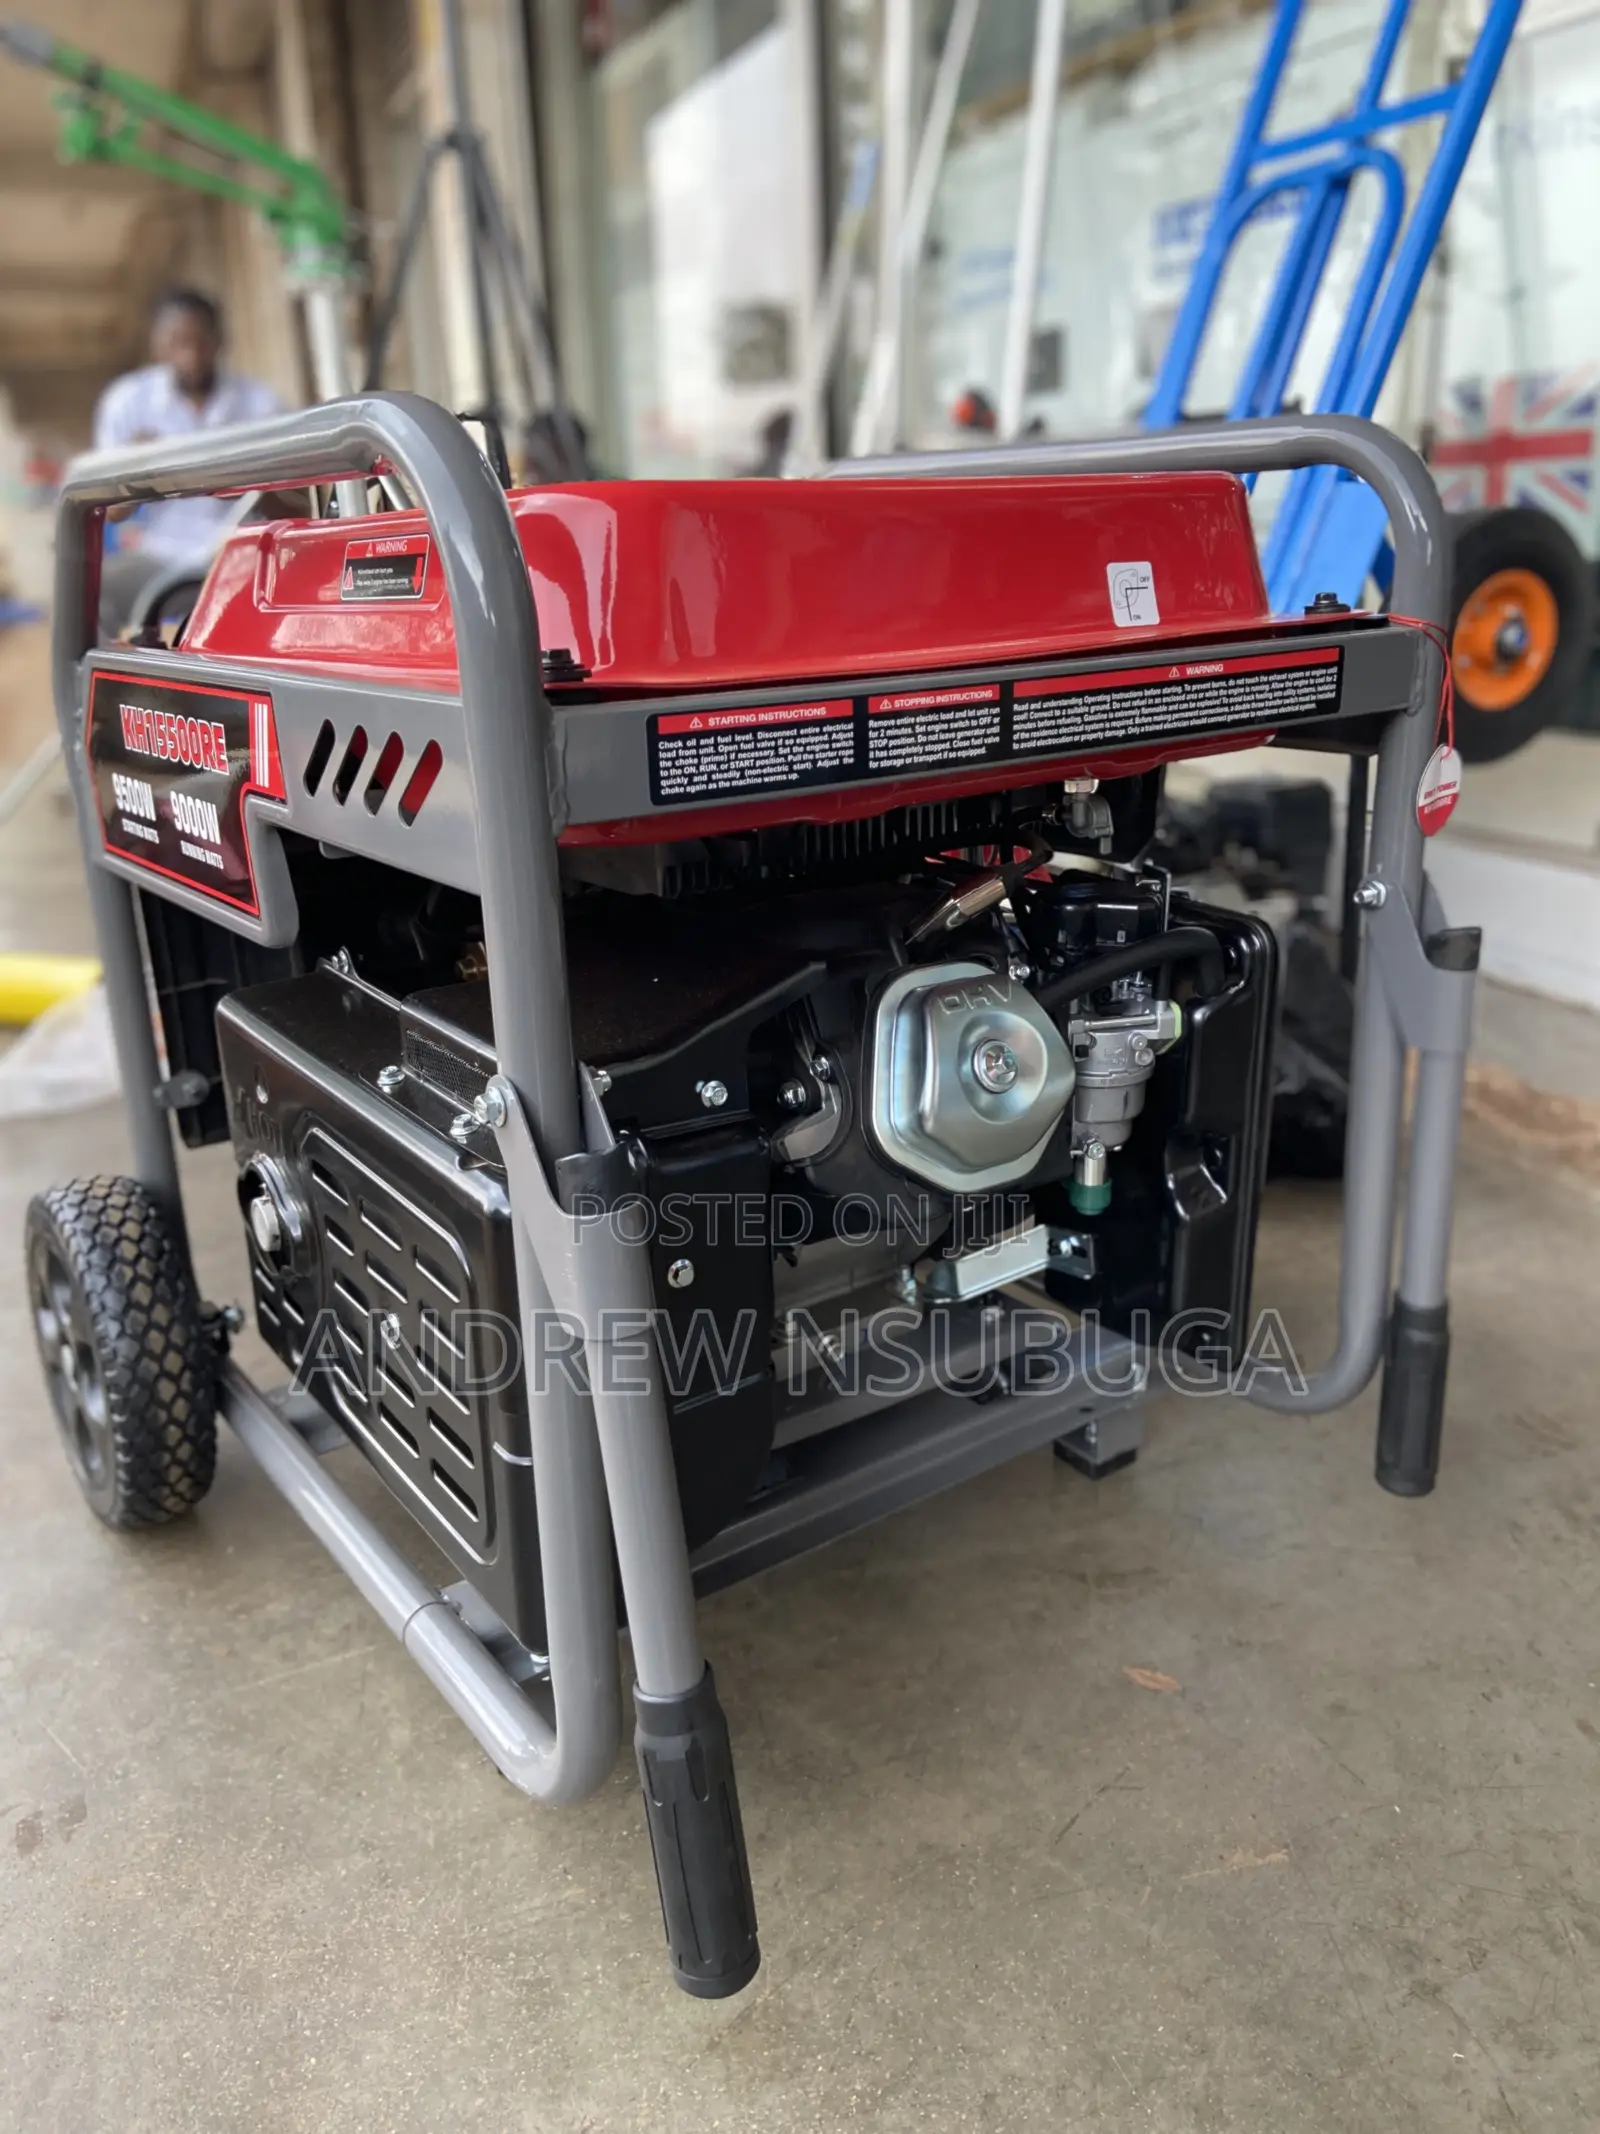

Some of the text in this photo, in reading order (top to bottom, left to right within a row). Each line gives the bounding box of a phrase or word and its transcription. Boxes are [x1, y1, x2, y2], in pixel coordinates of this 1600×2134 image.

[376, 540, 408, 554] WARNING
[1186, 664, 1224, 676] WARNING
[894, 690, 992, 708] STOPPING INSTRUCTIONS
[708, 707, 826, 726] STARTING INSTRUCTIONS
[868, 720, 895, 728] Remove
[896, 716, 915, 725] entire
[916, 713, 939, 723] electric
[940, 712, 954, 720] load
[955, 710, 967, 718] and
[967, 709, 976, 717] let
[976, 708, 989, 716] unit
[868, 730, 879, 738] for
[880, 729, 885, 737] 2
[886, 727, 914, 736] minutes.
[915, 724, 926, 732] Set
[927, 722, 949, 732] engine
[950, 719, 970, 728] switch
[979, 717, 992, 725] OFF
[119, 704, 230, 776] KH15500RE
[658, 740, 683, 749] Check
[700, 737, 715, 745] and
[717, 735, 732, 743] fuel
[735, 733, 753, 741] level.
[757, 729, 797, 739] Disconnect
[800, 727, 820, 735] entire
[823, 723, 854, 732] electrical
[659, 750, 676, 758] load
[699, 746, 716, 754] unit.
[757, 740, 775, 748] valve
[796, 734, 829, 744] equipped.
[831, 731, 854, 740] Adjust
[869, 739, 888, 748] STOP
[888, 736, 917, 747] position.
[917, 734, 927, 742] Do
[928, 733, 938, 741] not
[956, 728, 985, 739] generator
[986, 725, 1000, 734] until
[869, 750, 874, 758] it
[888, 745, 924, 756] completely
[925, 741, 951, 751] stopped.
[952, 740, 970, 748] Close
[971, 737, 983, 745] fuel
[984, 736, 1000, 744] valve
[700, 764, 718, 772] RUN,
[730, 760, 754, 768] START
[755, 757, 787, 767] position.
[788, 754, 801, 762] Pull
[815, 751, 837, 759] starter
[701, 754, 728, 764] (prime)
[737, 750, 776, 759] necessary.
[806, 743, 829, 752] engine
[832, 740, 854, 748] switch
[869, 760, 879, 768] for
[880, 758, 905, 767] storage
[913, 752, 942, 763] transport
[943, 751, 948, 759] if
[957, 747, 987, 758] equipped.
[660, 777, 689, 787] quickly
[693, 774, 708, 782] and
[711, 771, 741, 779] steadily
[744, 765, 789, 777] (non-electric
[793, 762, 813, 770] start).
[817, 759, 839, 768] Adjust
[112, 772, 156, 821] 9500W
[661, 787, 684, 795] choke
[685, 784, 707, 793] again
[732, 778, 762, 786] machine
[170, 790, 221, 844] 9000W
[937, 982, 1012, 1014] OHV
